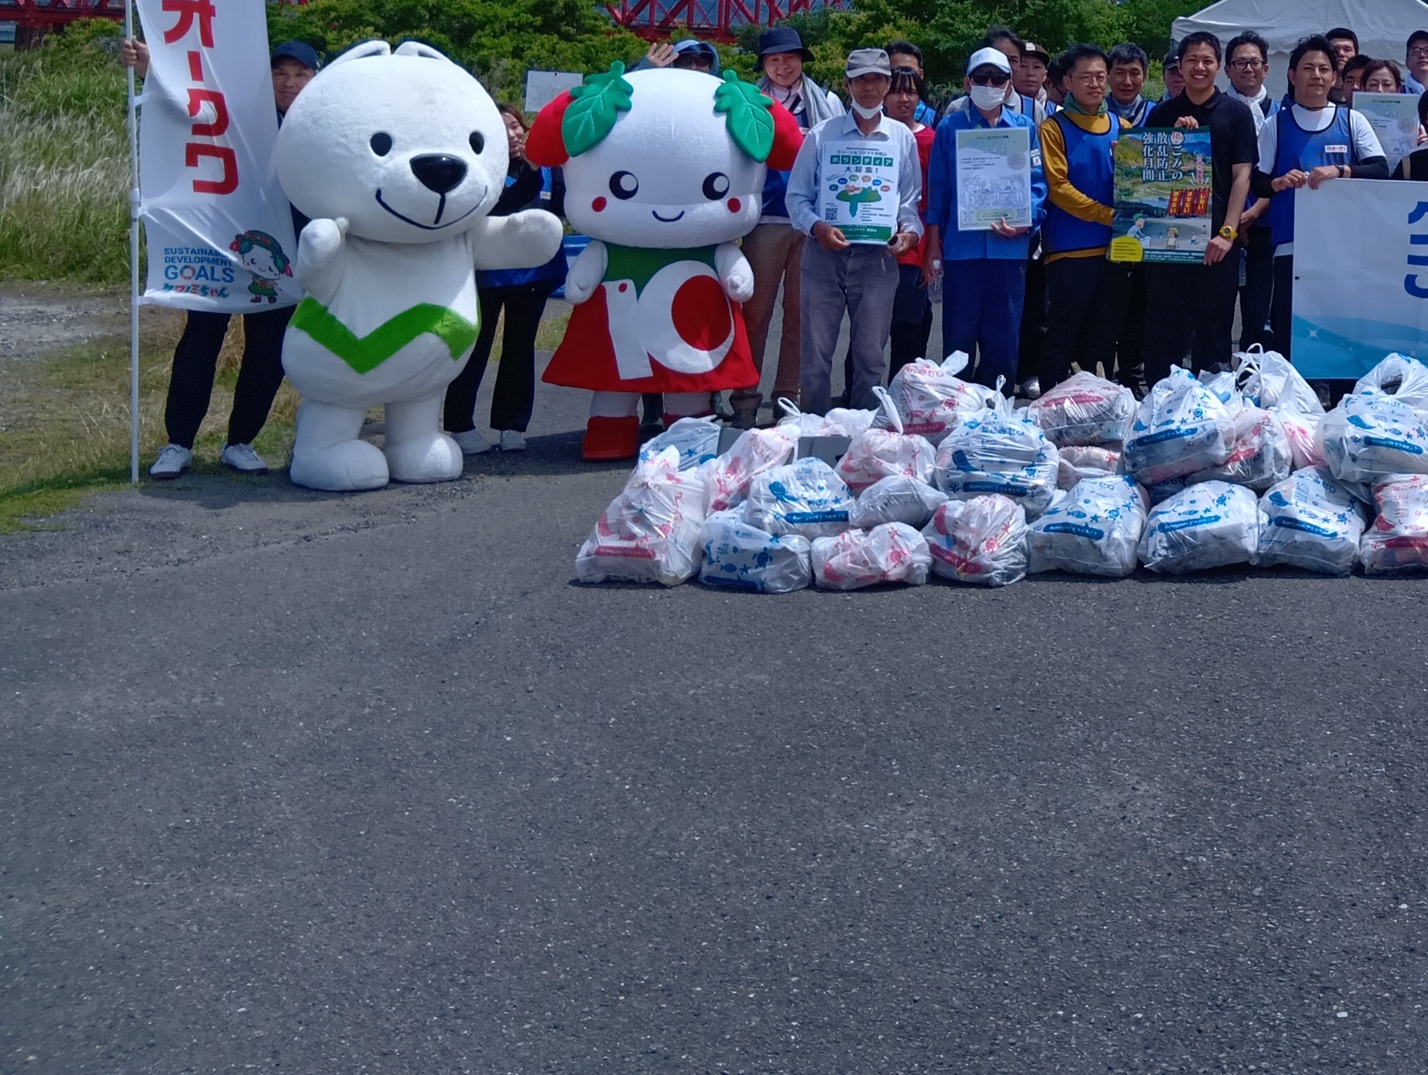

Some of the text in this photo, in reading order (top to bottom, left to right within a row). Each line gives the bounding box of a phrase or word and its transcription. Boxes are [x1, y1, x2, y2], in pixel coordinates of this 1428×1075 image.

[831, 155, 893, 166] ボランティア
[1142, 131, 1155, 182] 強化月間
[1156, 131, 1169, 181] 散乱防止
[164, 264, 235, 283] GOALS
